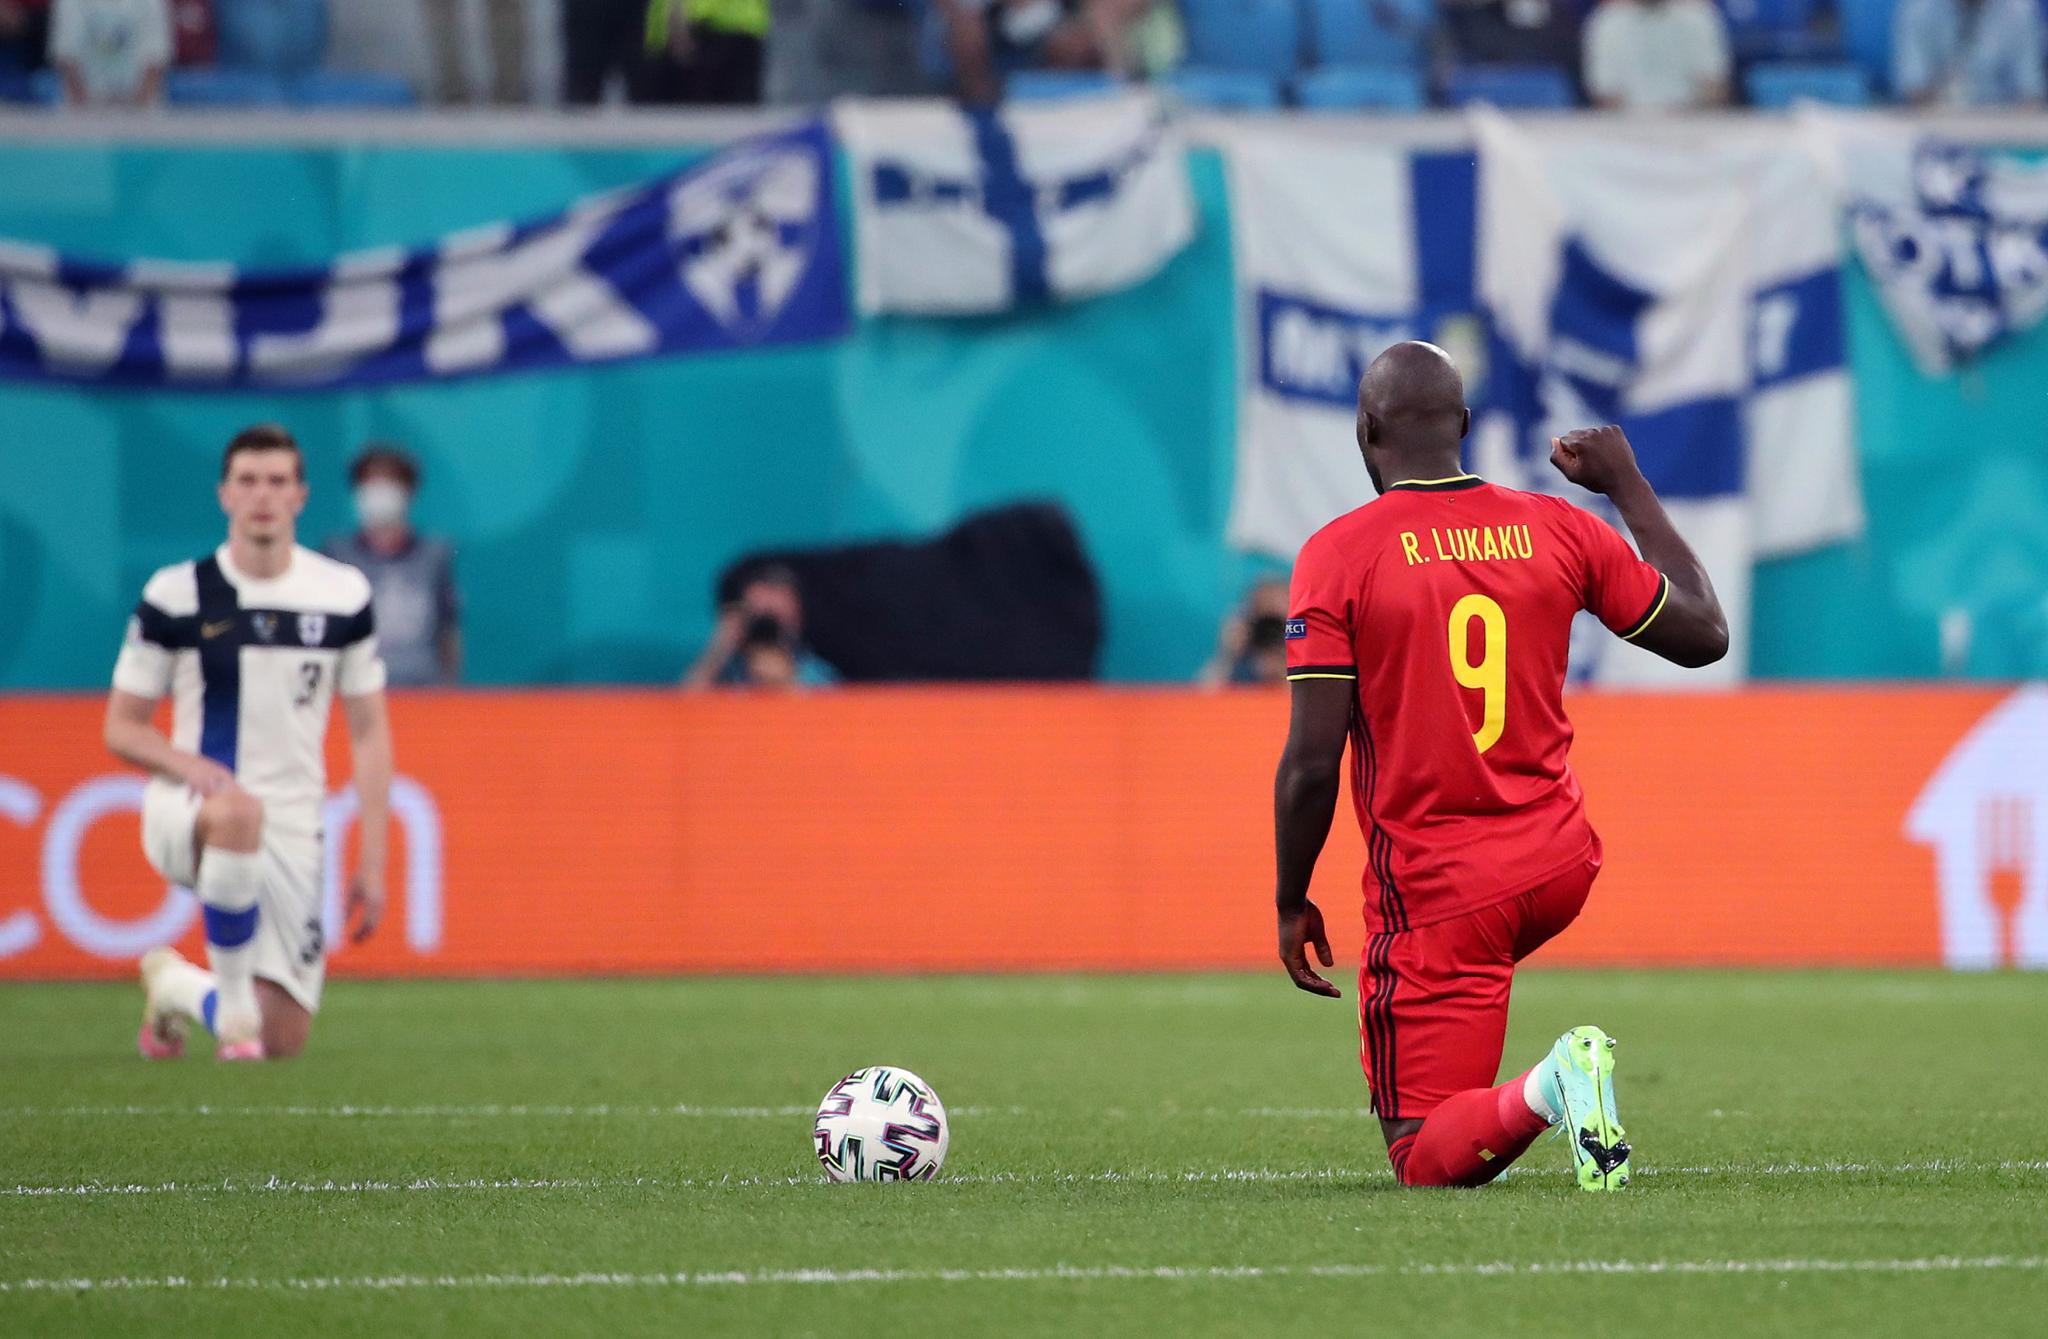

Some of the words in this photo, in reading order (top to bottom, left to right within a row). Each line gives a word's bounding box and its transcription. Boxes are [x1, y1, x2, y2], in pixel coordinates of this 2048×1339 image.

[1400, 531, 1431, 566] R.
[1431, 524, 1533, 562] LUKAKU
[295, 661, 323, 707] 3
[1448, 593, 1507, 755] 9
